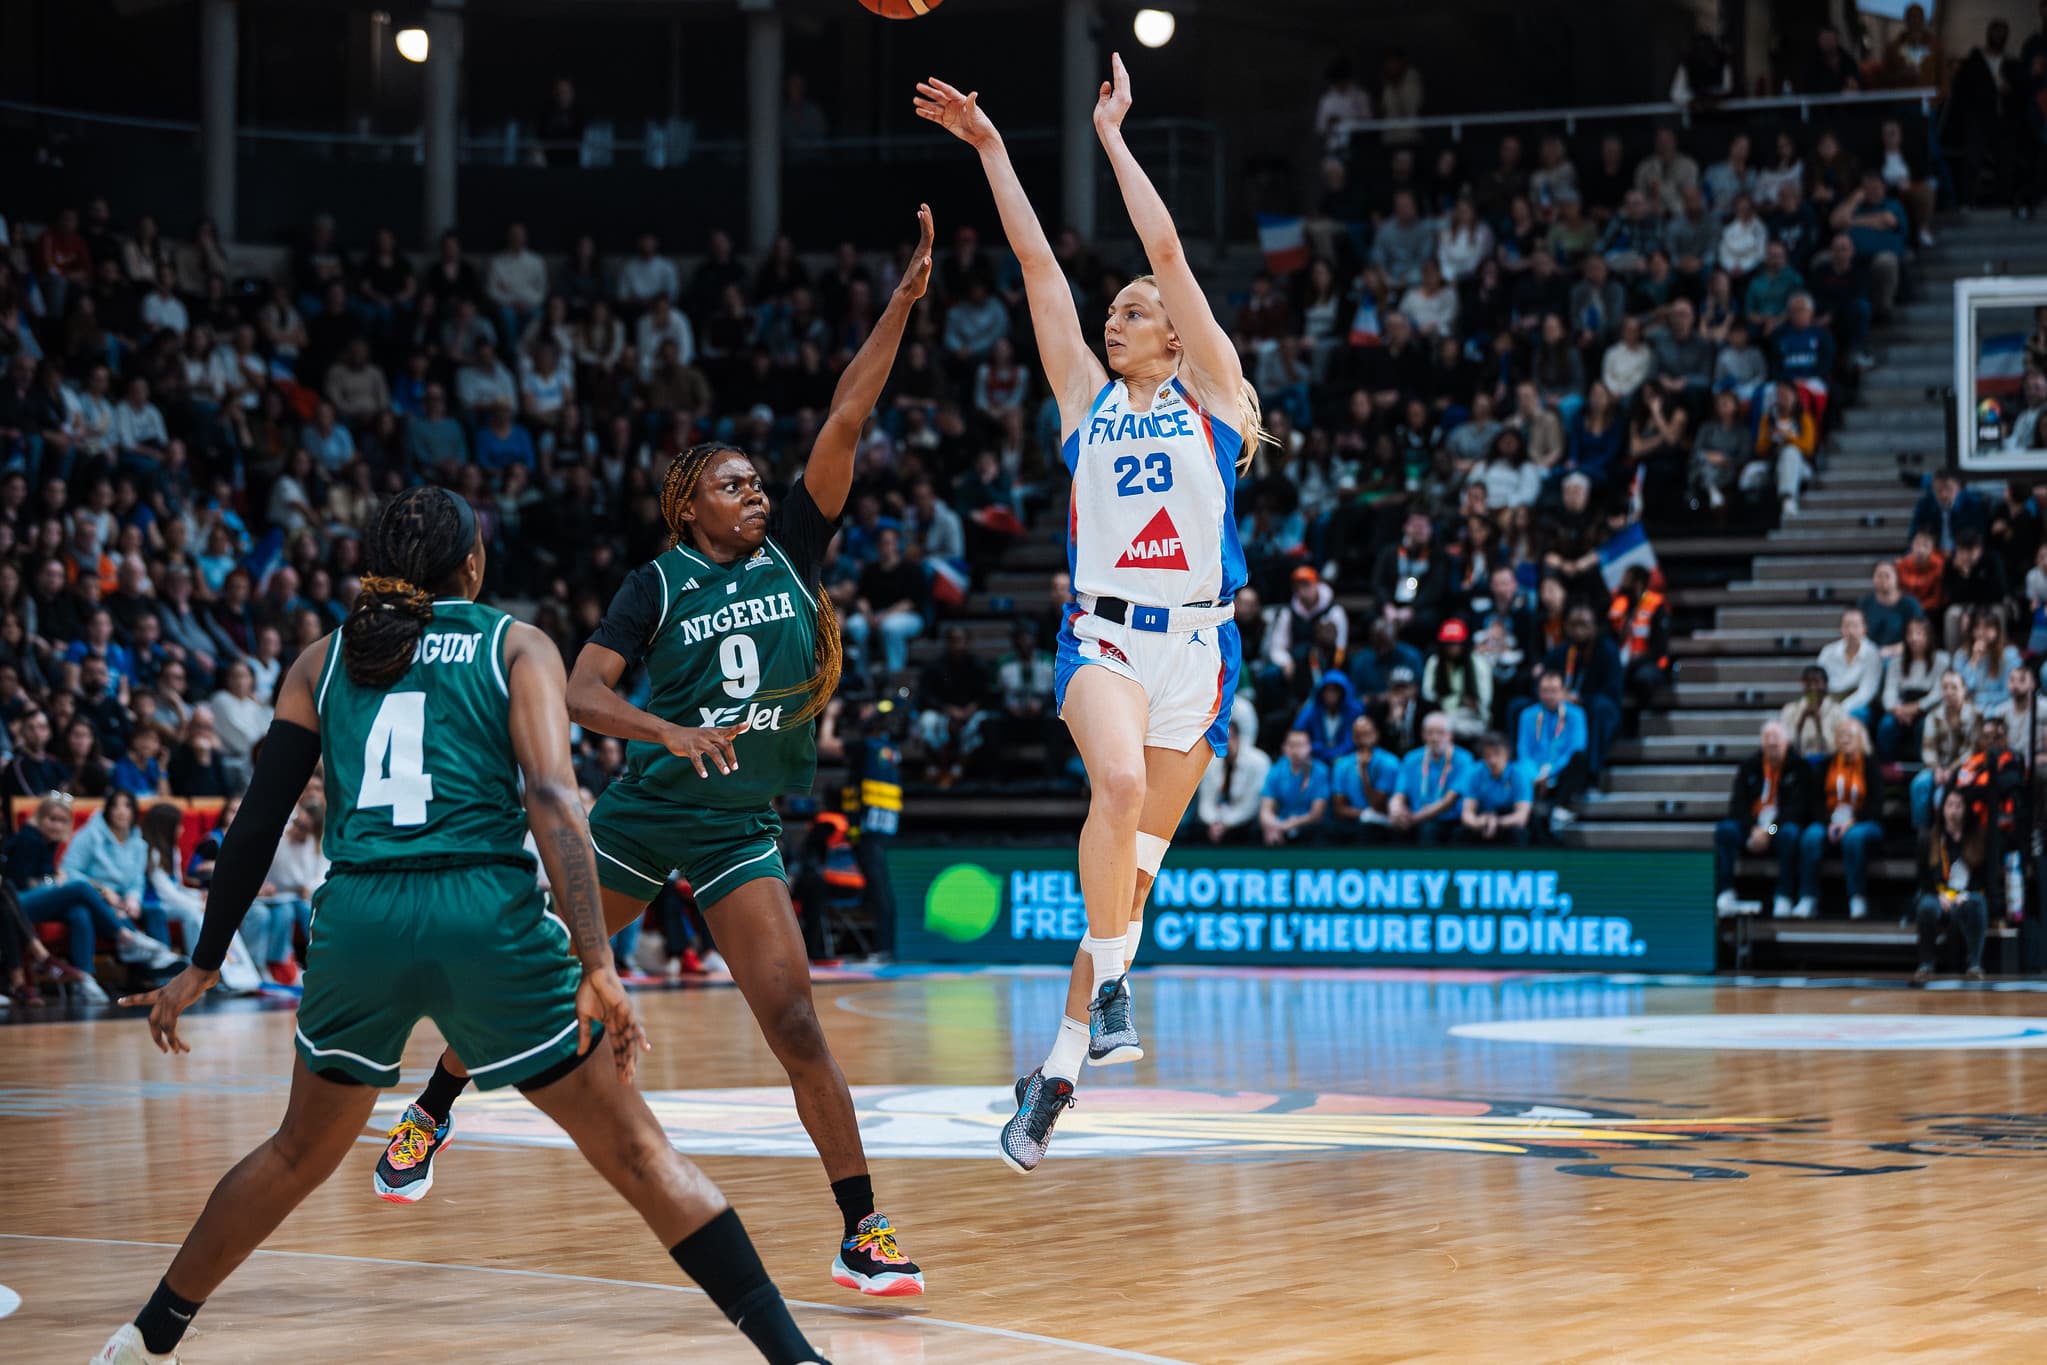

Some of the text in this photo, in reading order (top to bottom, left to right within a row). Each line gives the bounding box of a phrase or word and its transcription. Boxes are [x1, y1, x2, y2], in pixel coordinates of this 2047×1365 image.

[1088, 409, 1194, 445] FRANCE
[1113, 452, 1174, 497] 23
[1126, 538, 1183, 561] MAIF
[680, 592, 796, 646] NIGERIA
[719, 633, 761, 699] 9
[357, 691, 433, 827] 4
[1154, 869, 1573, 917] NOTRE MONEY TIME,
[1435, 914, 1496, 954] DU
